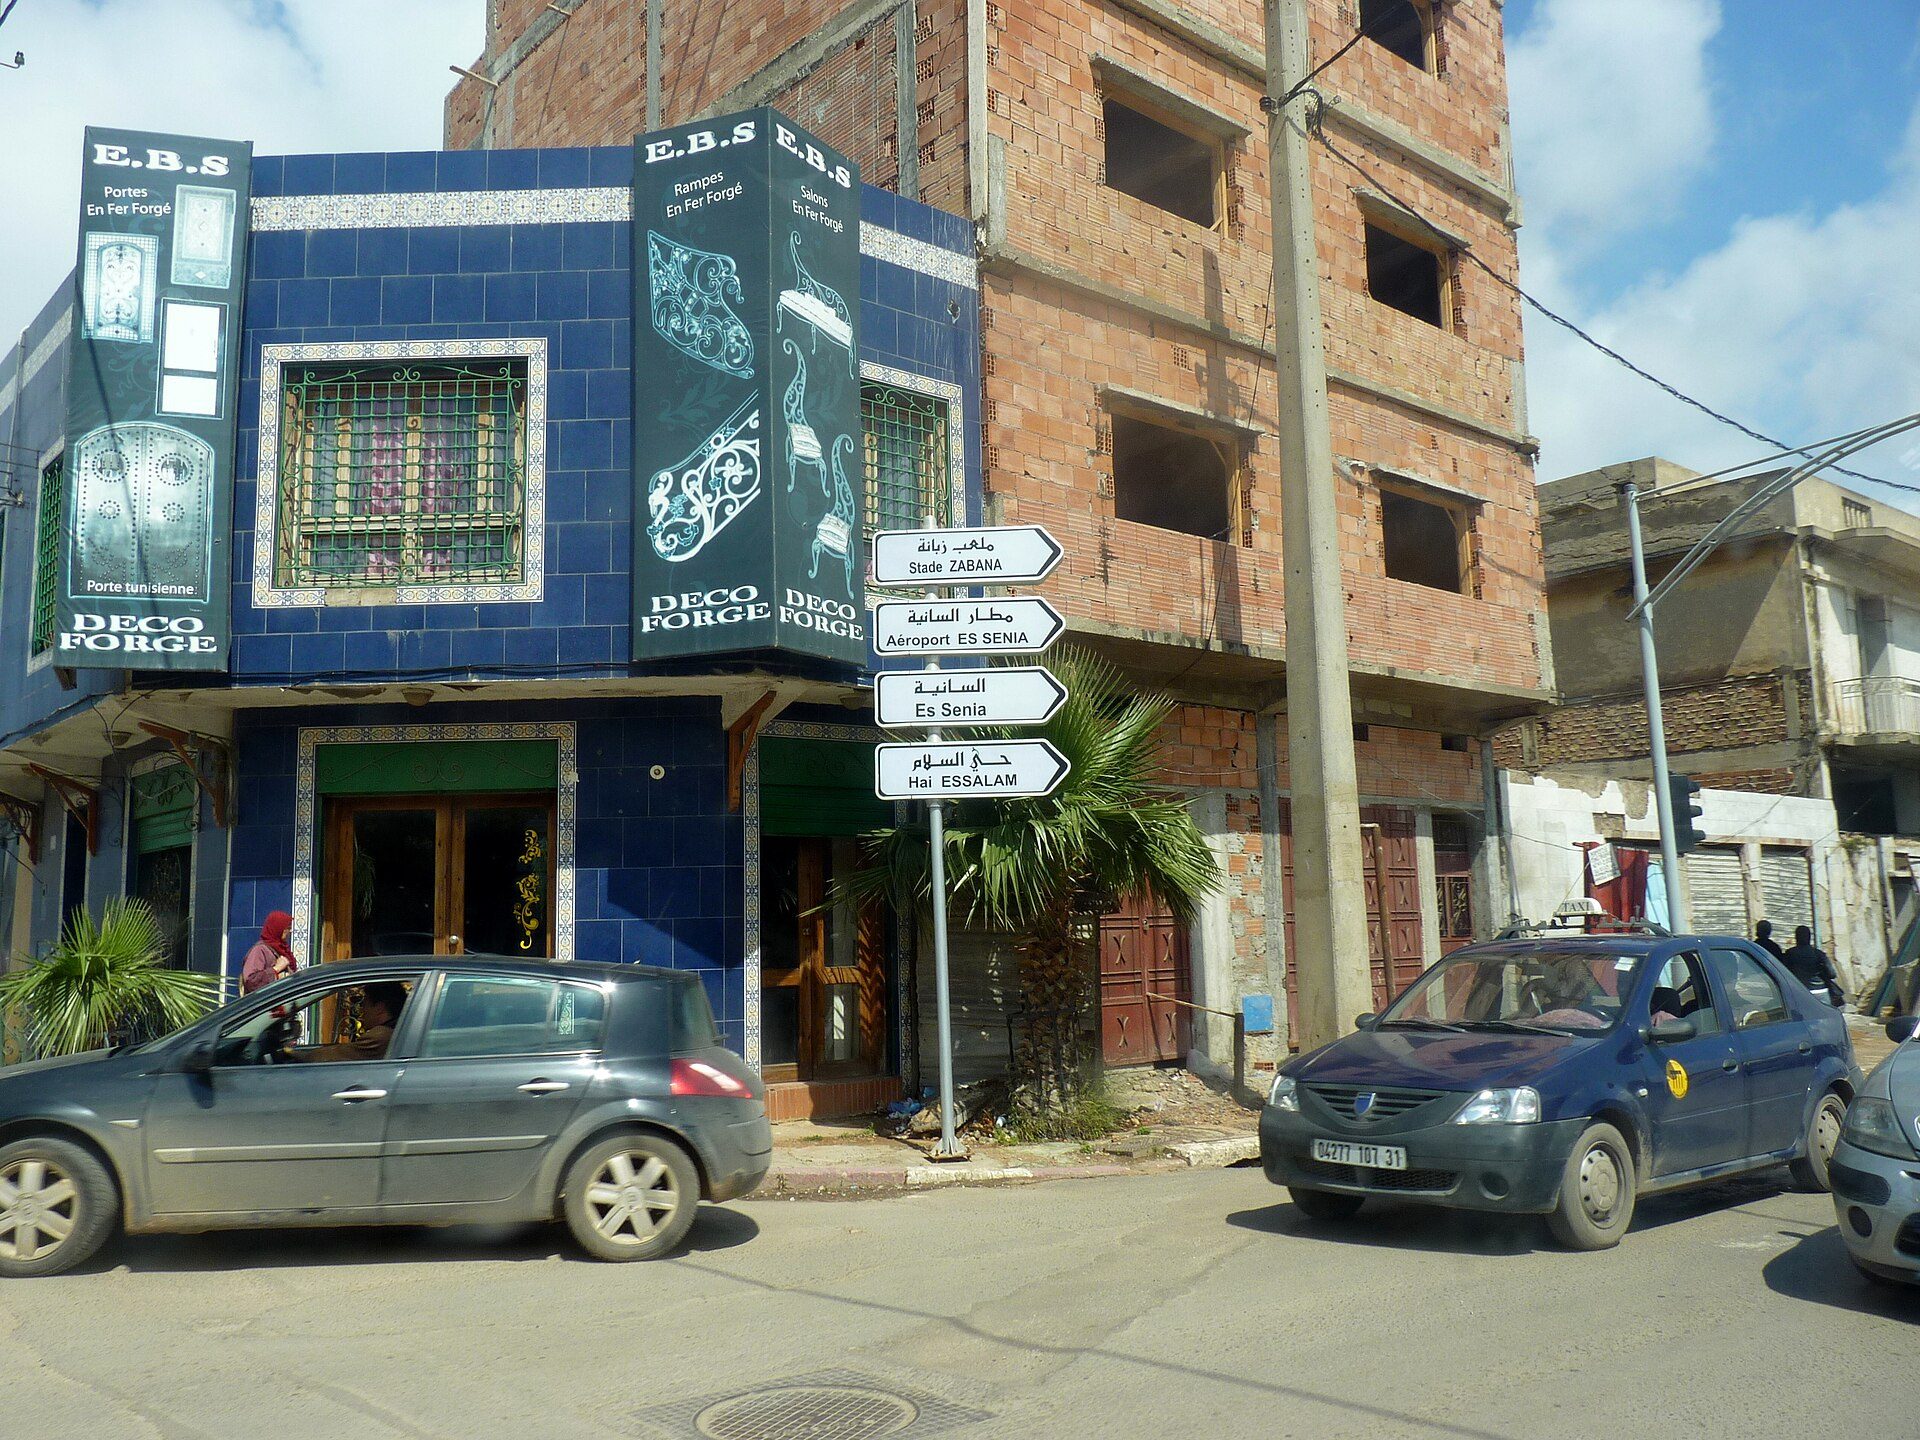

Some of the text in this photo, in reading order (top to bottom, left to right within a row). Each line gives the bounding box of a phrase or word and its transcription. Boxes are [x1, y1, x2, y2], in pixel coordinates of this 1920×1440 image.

[645, 121, 757, 164] E.B.S
[93, 143, 230, 177] E.B.S
[776, 123, 851, 189] E.B.S
[104, 186, 148, 198] Portes
[674, 171, 724, 197] Rampes
[667, 182, 743, 218] En Fer Forgé
[801, 185, 828, 208] Salons
[87, 203, 171, 217] En Fer Forgé
[792, 200, 844, 233] En Fer Forgé
[918, 537, 994, 554] ملعب زبانة
[909, 558, 1003, 574] Stade ZABANA
[87, 580, 122, 592] Porte
[651, 585, 760, 613] DECO
[786, 588, 856, 620] DECO
[73, 613, 204, 634] DECO
[641, 602, 771, 633] FORGE
[779, 604, 864, 641] FORGE
[908, 607, 1013, 626] مطار السانية
[59, 632, 218, 653] FORGE
[886, 631, 1028, 648] Aéroport ES SENIA
[914, 677, 986, 696] السانية
[915, 702, 987, 717] Es Senia
[912, 752, 964, 771] السلام
[908, 774, 1017, 789] Hai ESSALAM
[1562, 901, 1590, 912] TAXI
[1318, 1142, 1351, 1162] 04277
[1386, 1149, 1400, 1167] 31
